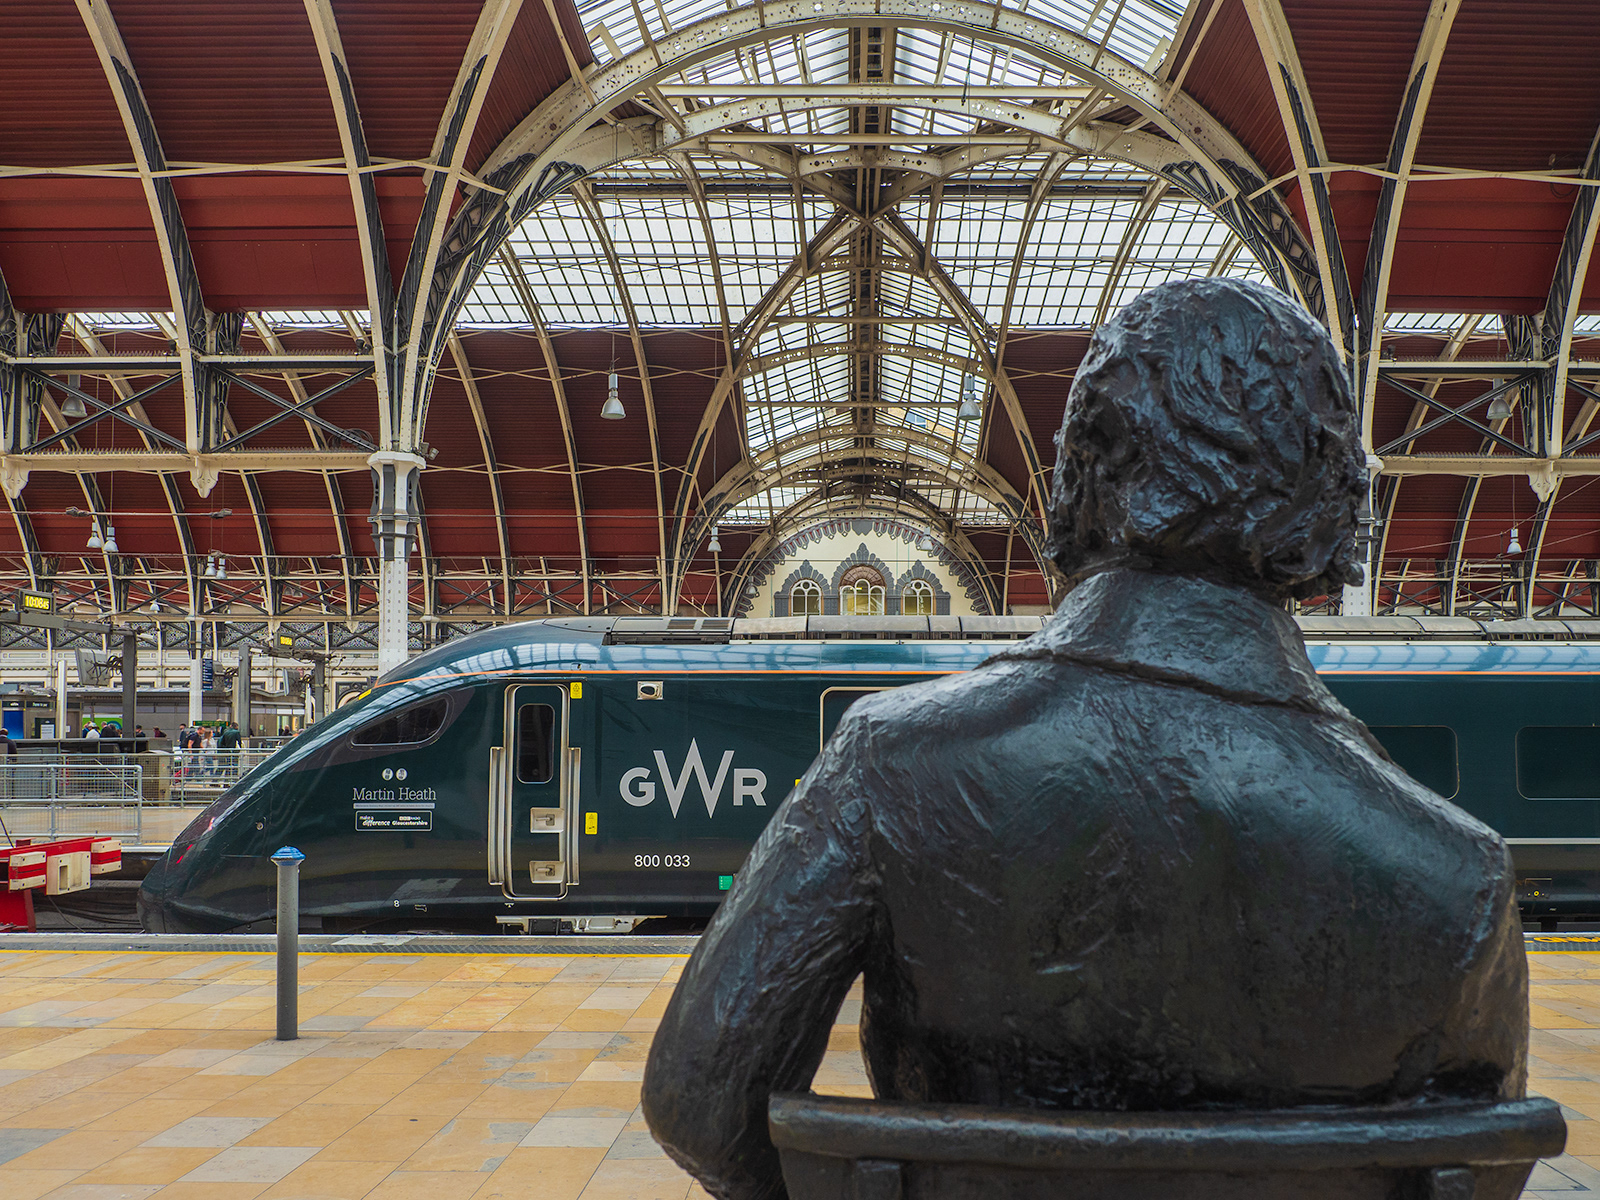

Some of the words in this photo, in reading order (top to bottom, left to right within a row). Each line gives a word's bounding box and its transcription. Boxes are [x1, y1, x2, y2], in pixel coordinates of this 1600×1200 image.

[619, 737, 767, 819] GWR
[352, 787, 395, 801] Martin
[398, 787, 437, 801] Heath
[634, 854, 660, 868] 800
[664, 854, 691, 868] 033
[393, 899, 400, 908] 8
